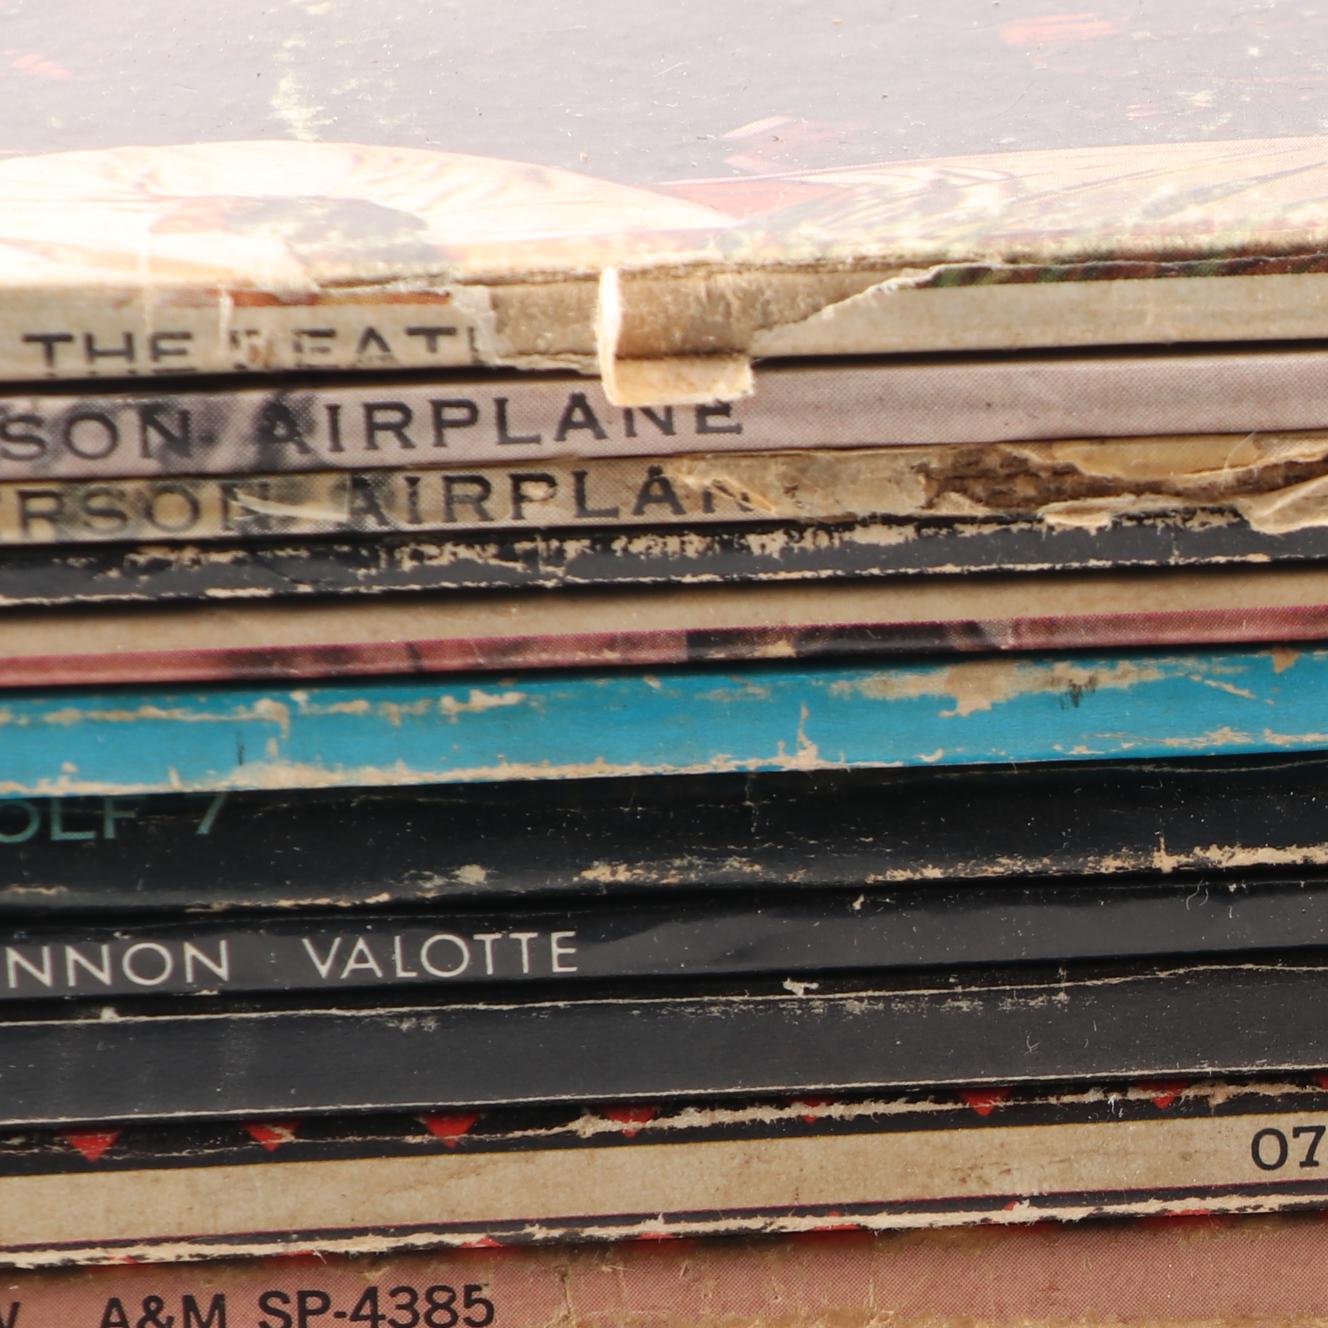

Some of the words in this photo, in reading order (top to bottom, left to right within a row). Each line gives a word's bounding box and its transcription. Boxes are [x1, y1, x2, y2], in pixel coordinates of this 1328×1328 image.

[22, 331, 196, 376] THE
[260, 392, 744, 455] AIRPLANE
[6, 940, 229, 988] NNON
[302, 931, 579, 979] VALOTTE
